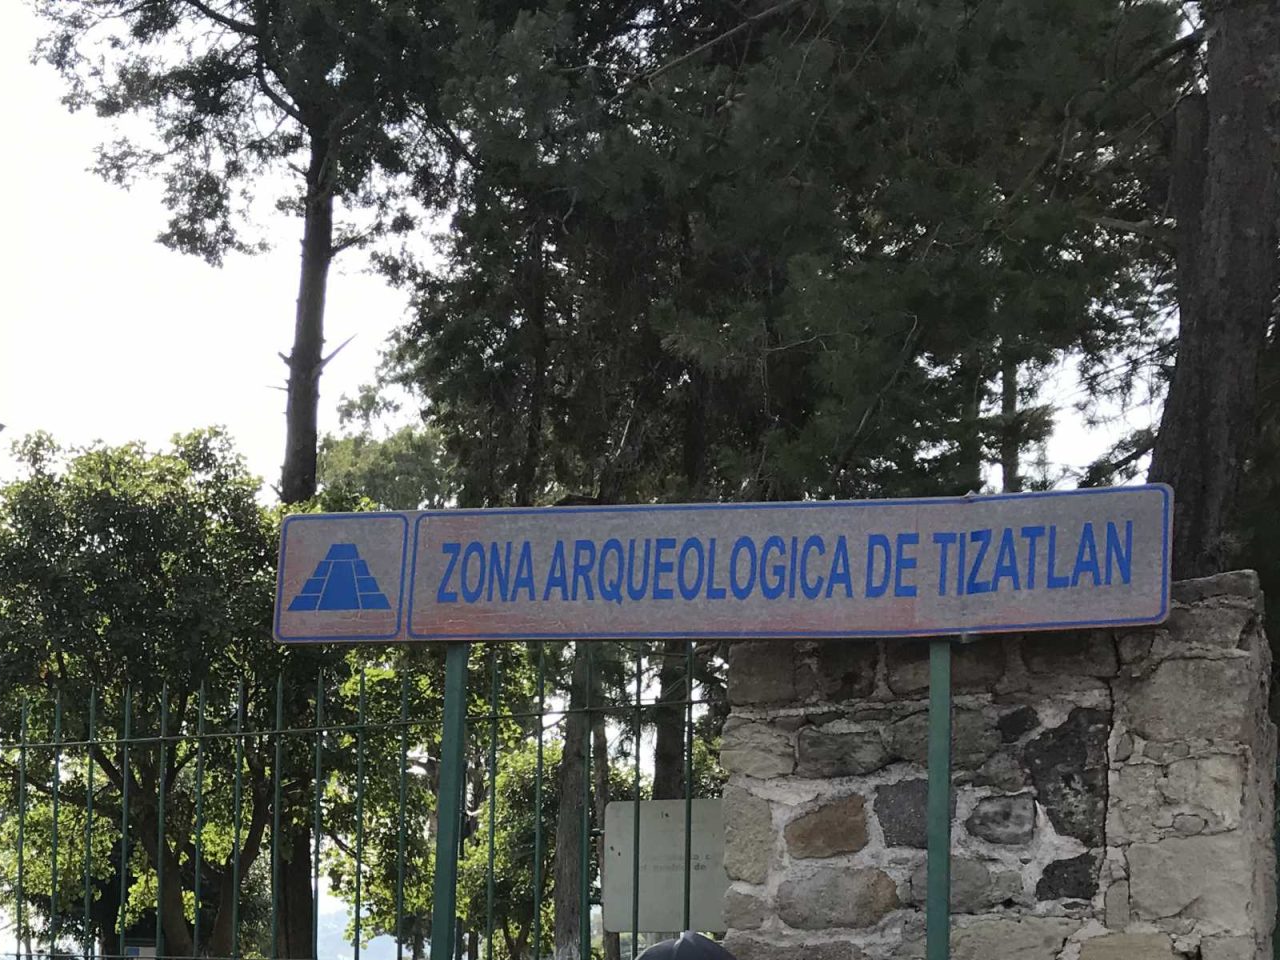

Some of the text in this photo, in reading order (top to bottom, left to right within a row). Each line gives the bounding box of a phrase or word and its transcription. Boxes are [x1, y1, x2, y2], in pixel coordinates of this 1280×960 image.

[437, 519, 1134, 604] ZONA ARQUEOLOGICA DE TIZATLAN
